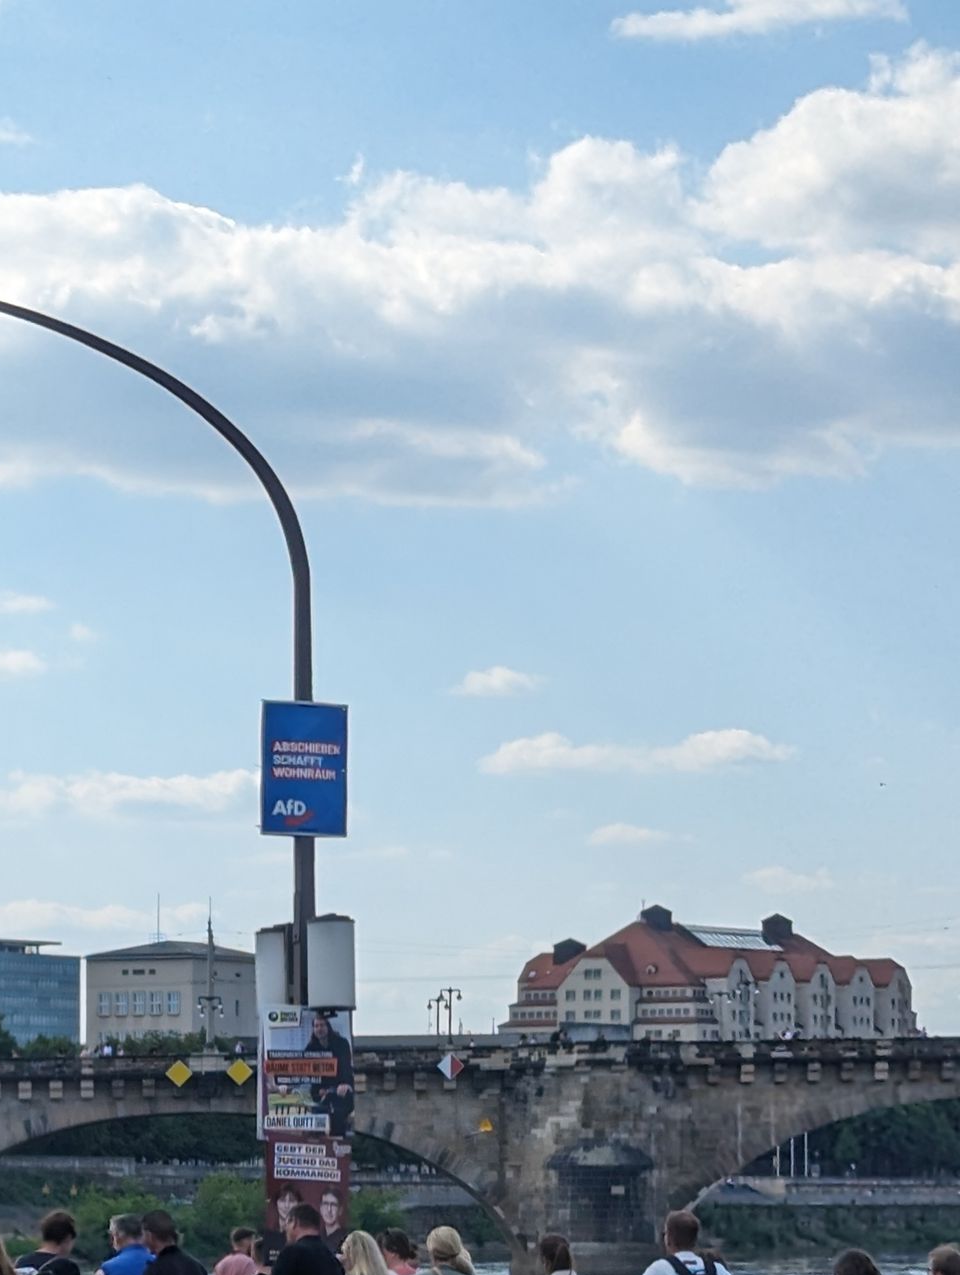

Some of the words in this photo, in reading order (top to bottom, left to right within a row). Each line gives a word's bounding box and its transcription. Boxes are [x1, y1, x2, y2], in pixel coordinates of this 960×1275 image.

[272, 741, 341, 755] ABSCHIEBEN
[272, 754, 323, 768] SCHAFFT
[272, 767, 337, 781] WOHNRAUM
[271, 798, 307, 817] AfD
[266, 1116, 291, 1129] DANIEL
[278, 1156, 317, 1166] JUGEND
[319, 1158, 336, 1168] DAS
